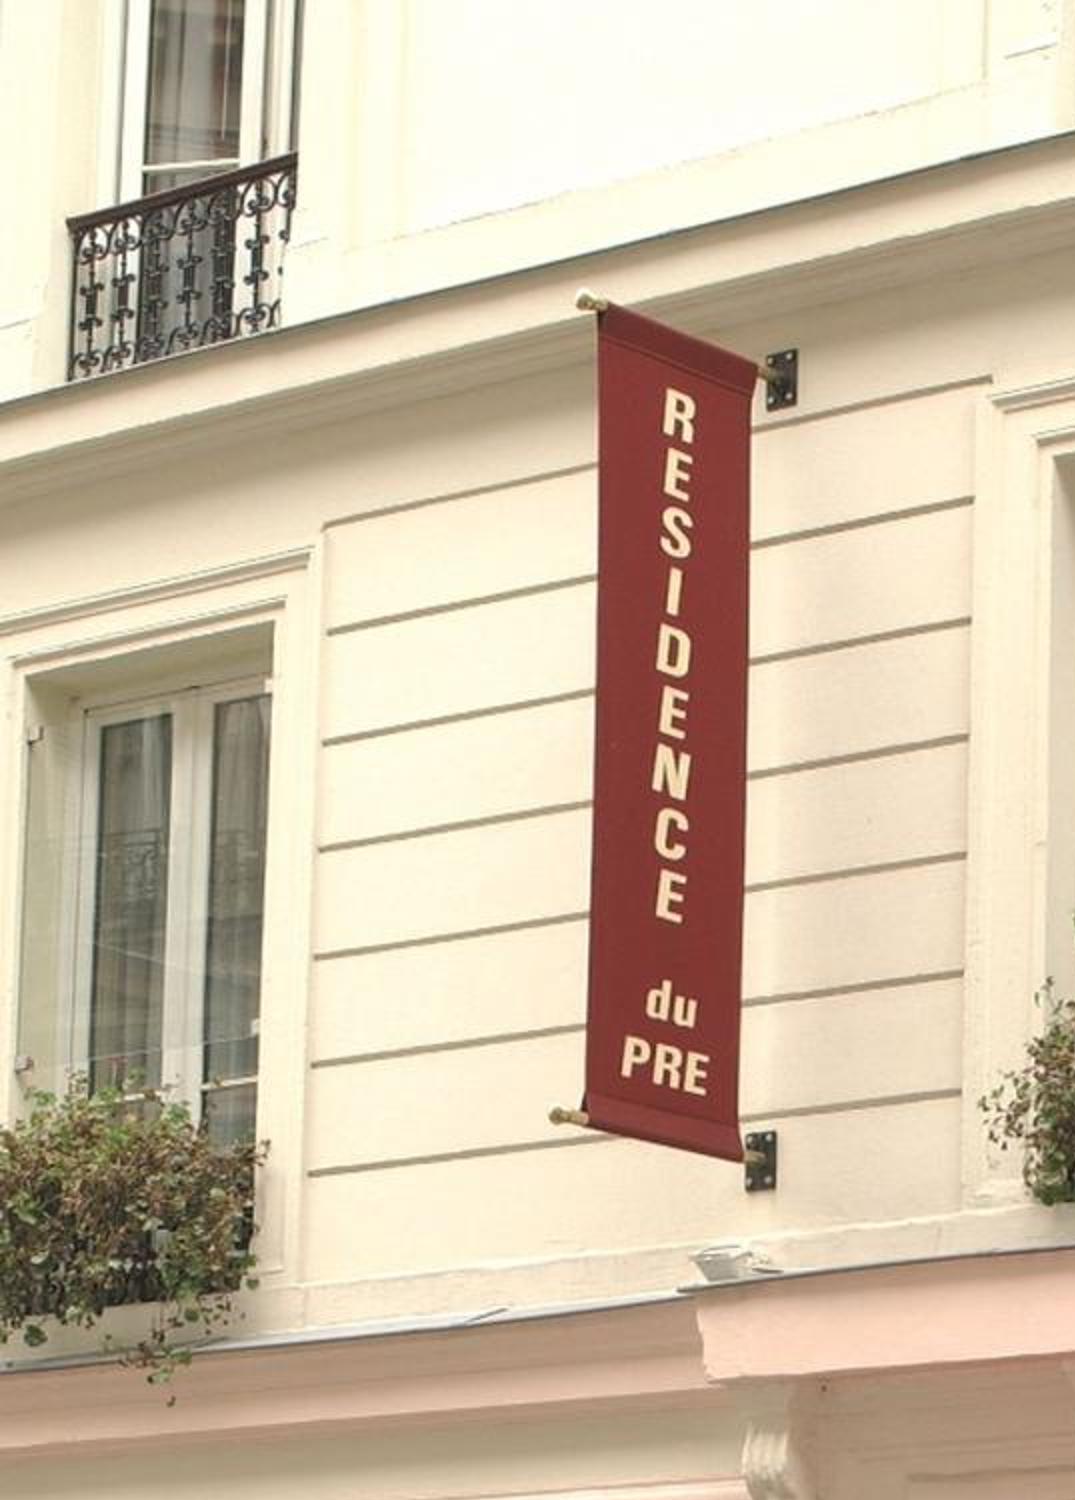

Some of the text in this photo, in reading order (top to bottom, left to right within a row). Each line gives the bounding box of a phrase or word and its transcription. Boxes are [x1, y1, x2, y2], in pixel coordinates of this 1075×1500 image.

[650, 386, 697, 924] RESIDENCE
[645, 979, 699, 1029] du
[620, 1035, 710, 1097] PRE
